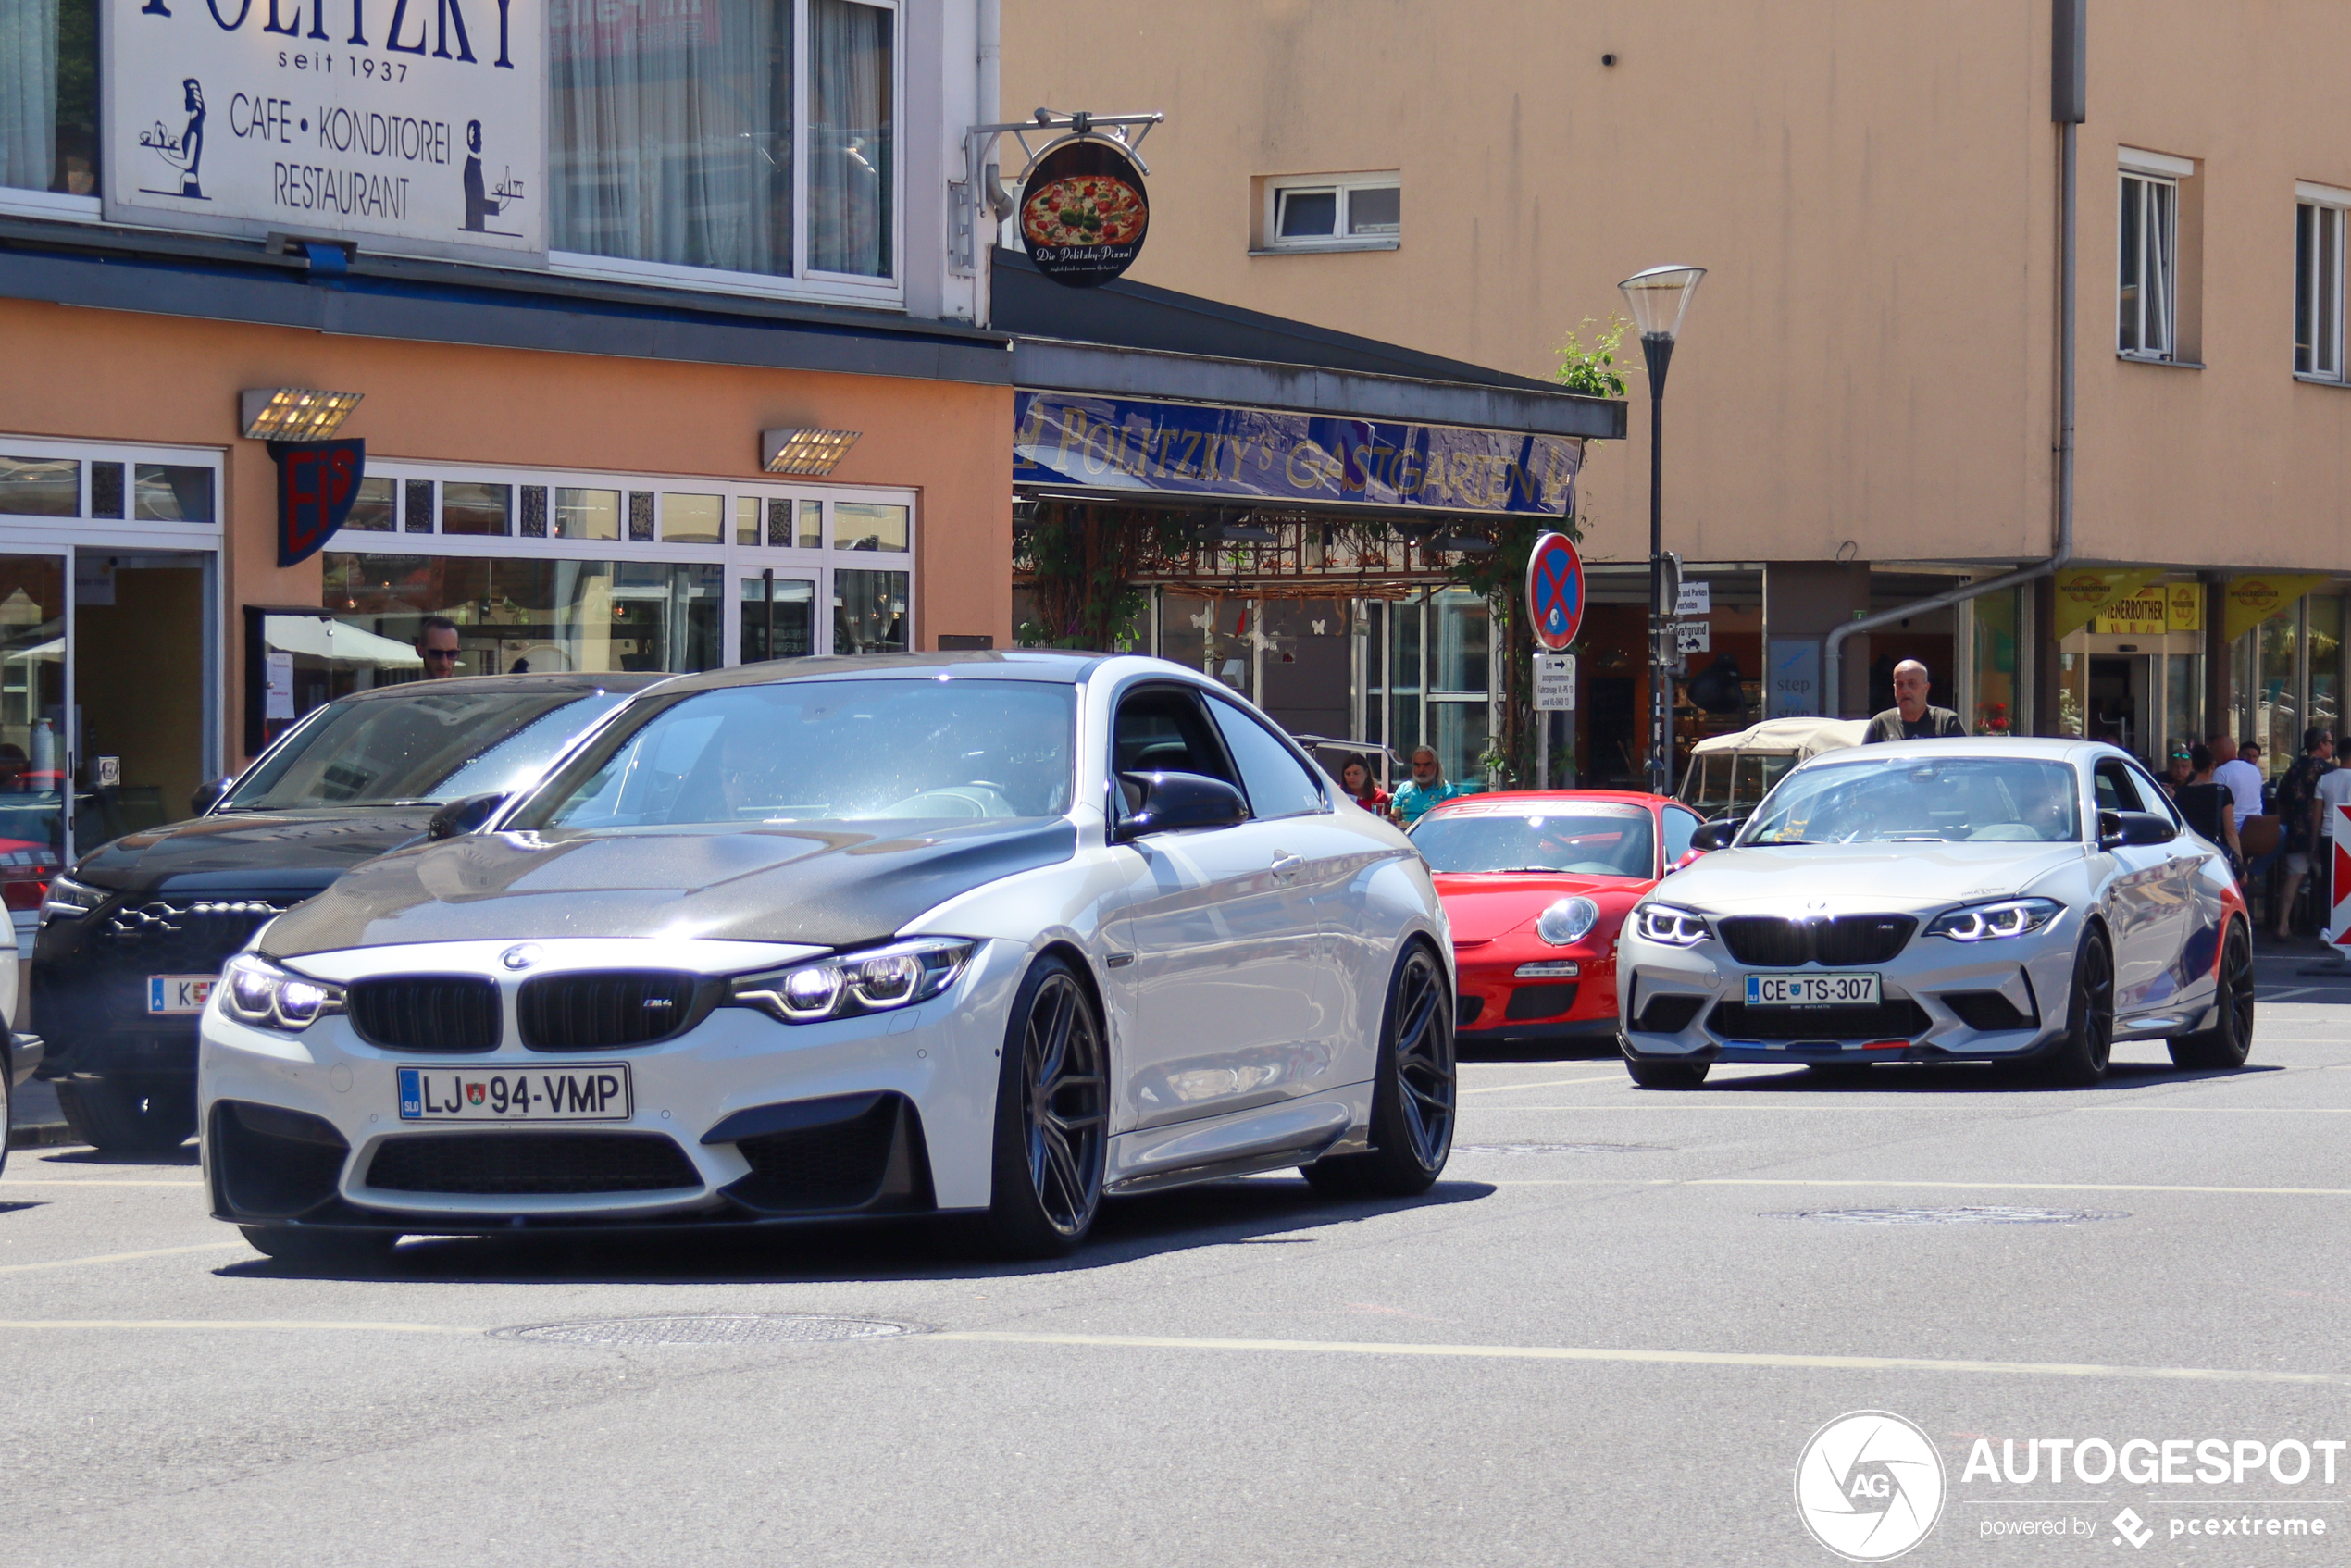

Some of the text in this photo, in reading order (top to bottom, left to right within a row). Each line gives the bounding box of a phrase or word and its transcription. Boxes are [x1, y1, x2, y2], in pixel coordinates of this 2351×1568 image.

[142, 0, 516, 70] TZKY
[278, 50, 409, 84] seit 1937
[230, 93, 452, 166] CAFE KONDITOREI
[274, 161, 410, 221] RESTAURANT
[1036, 247, 1056, 262] Die
[1285, 439, 1537, 508] GASTGARTEN
[1692, 588, 1708, 597] Parken
[1677, 601, 1698, 610] verboten
[1669, 623, 1707, 639] Pvatgrund
[1541, 674, 1570, 683] ausgenommen
[1777, 678, 1810, 694] step
[1785, 691, 1801, 710] by
[179, 981, 191, 1006] K
[1748, 993, 1759, 1002] SLO
[1762, 978, 1872, 1001] CE TS-307
[155, 998, 162, 1007] A
[647, 998, 673, 1007] M4
[423, 1074, 619, 1114] LJ 94-VMP
[404, 1101, 419, 1113] SLO
